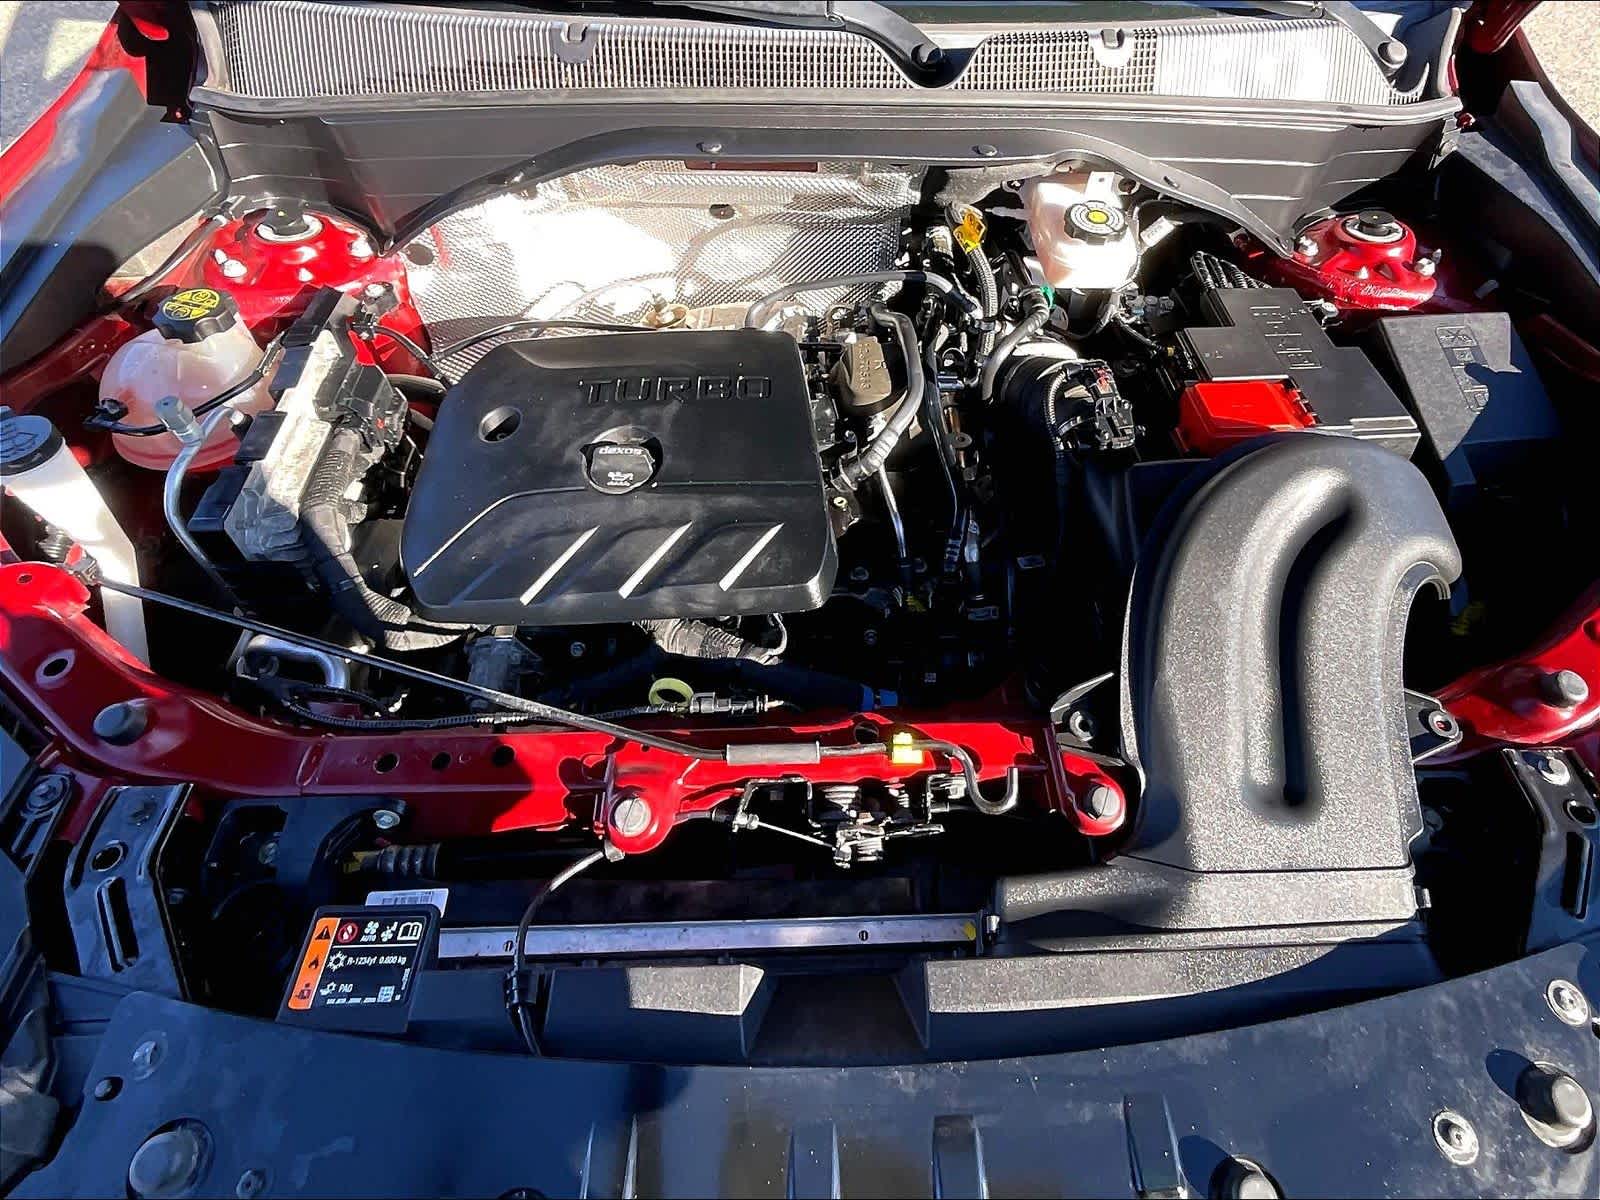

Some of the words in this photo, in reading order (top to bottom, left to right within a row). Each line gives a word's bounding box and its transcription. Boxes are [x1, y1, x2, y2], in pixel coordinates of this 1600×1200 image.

[578, 376, 772, 404] TURBO
[599, 446, 643, 455] dexos
[360, 934, 377, 942] AUTO
[397, 956, 407, 965] kg
